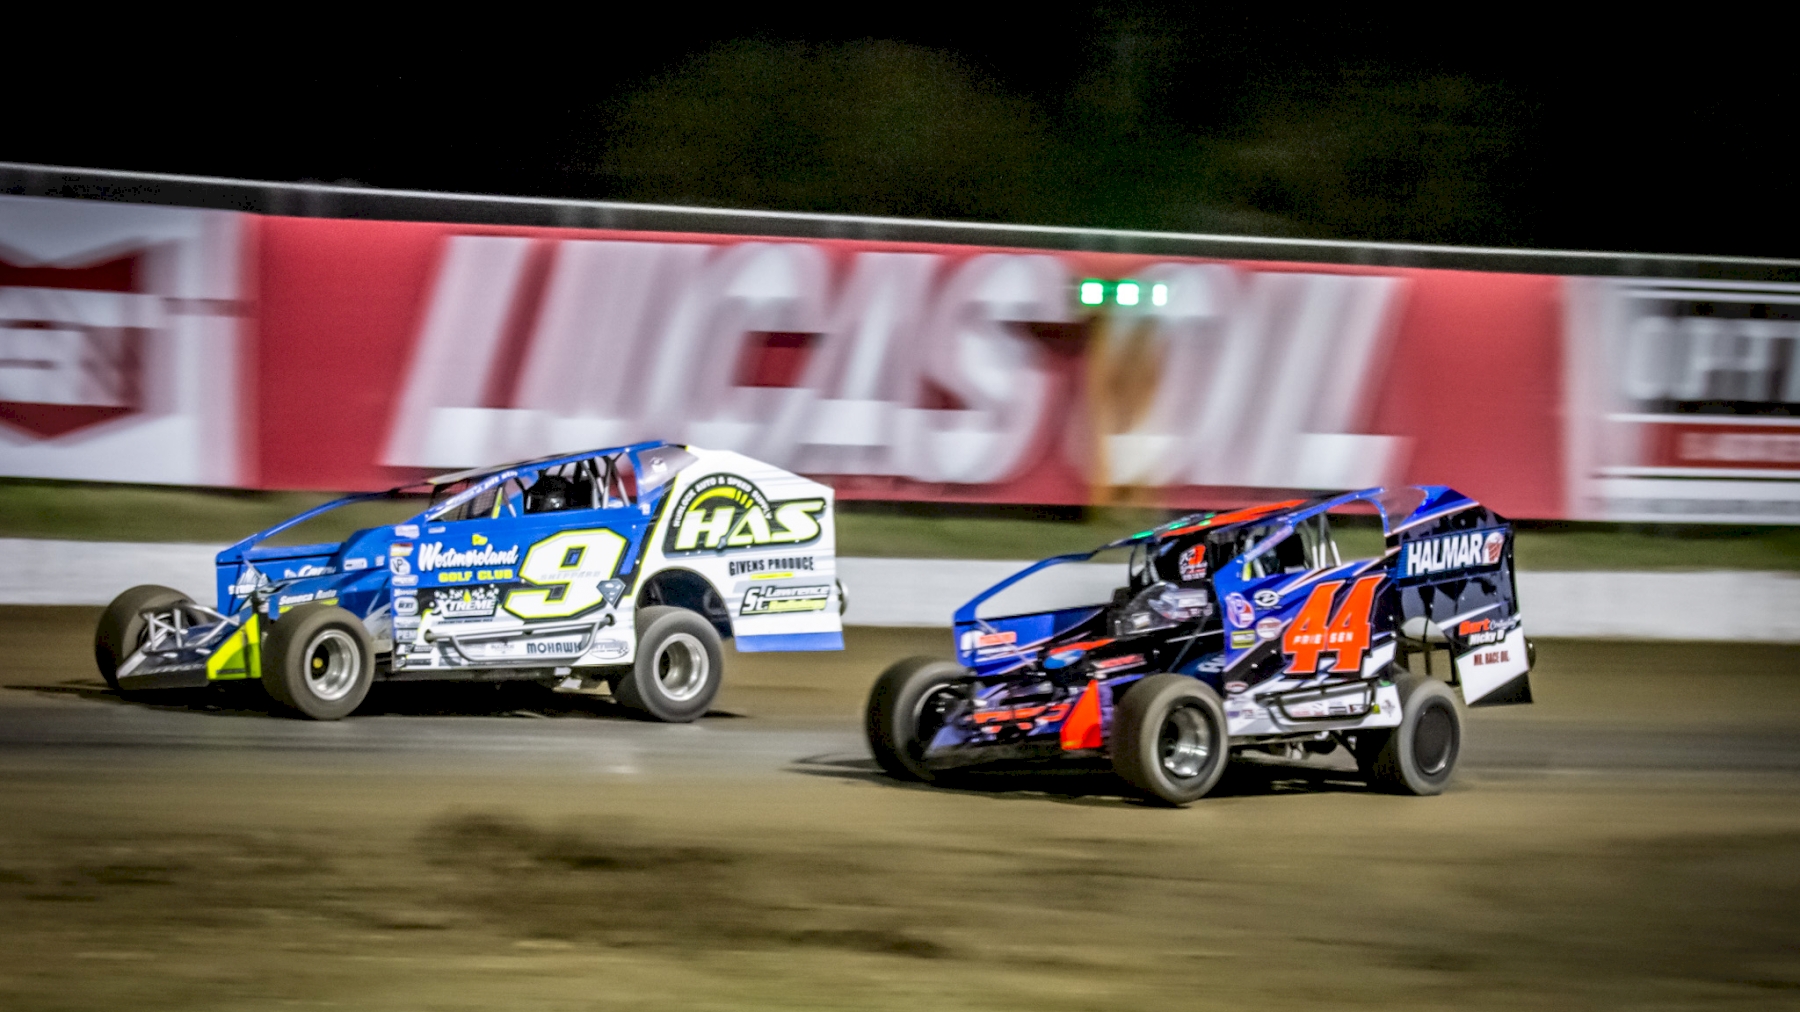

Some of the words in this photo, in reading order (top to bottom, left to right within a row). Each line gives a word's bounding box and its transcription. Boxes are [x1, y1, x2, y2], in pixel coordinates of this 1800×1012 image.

[385, 232, 1072, 485] LUCAS
[695, 476, 717, 492] AUTO
[718, 476, 725, 485] &
[727, 477, 752, 492] SPEED
[751, 490, 773, 519] SUPPLY
[674, 500, 825, 550] HAS
[418, 541, 519, 572] Westmoreland
[438, 570, 473, 582] GOLF
[477, 568, 513, 581] CLUB
[504, 527, 629, 620] 9
[729, 560, 765, 576] GIVENS
[768, 556, 814, 571] PRODUCE
[1407, 532, 1483, 577] HALMAR
[1283, 573, 1387, 674] 44
